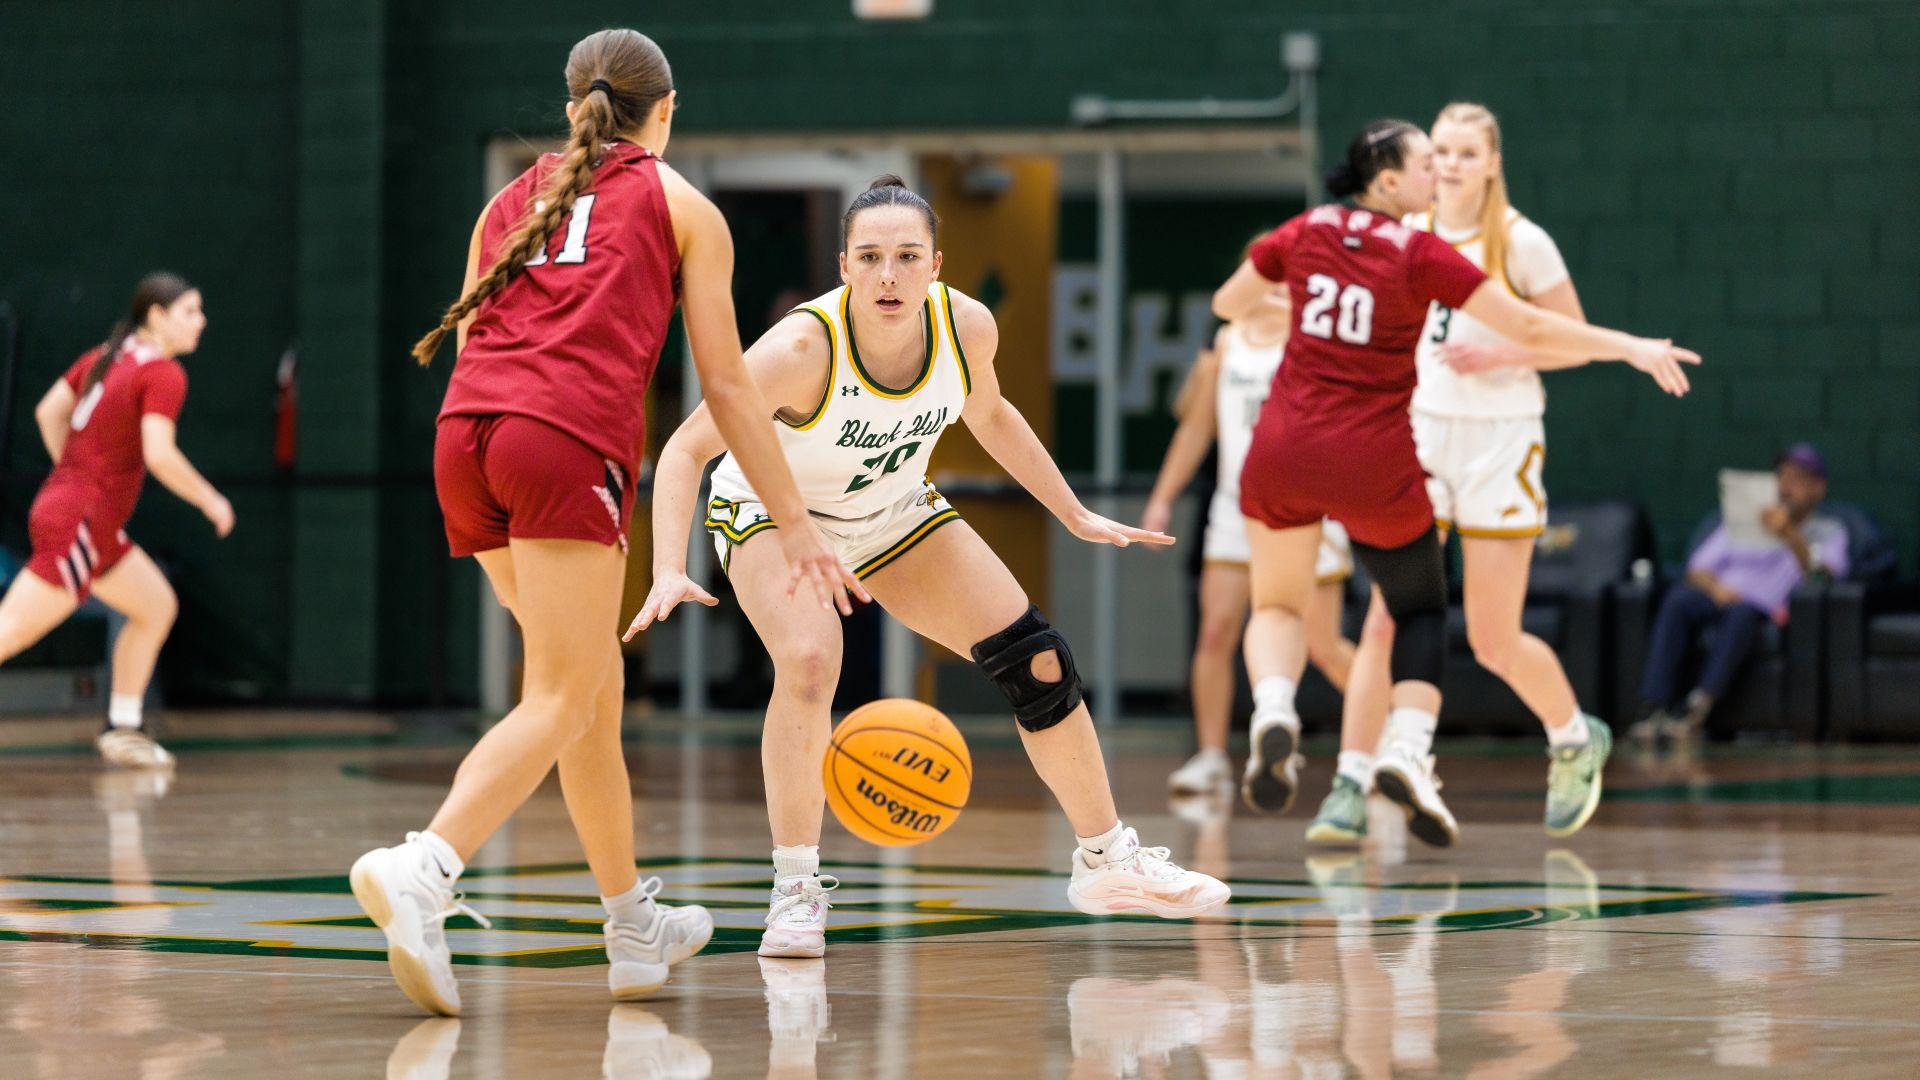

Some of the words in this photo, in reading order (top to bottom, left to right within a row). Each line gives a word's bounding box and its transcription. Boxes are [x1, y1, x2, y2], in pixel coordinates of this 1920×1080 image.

[1301, 273, 1375, 346] 20
[836, 419, 903, 449] Black
[843, 441, 922, 494] 20
[856, 777, 942, 833] Wilson
